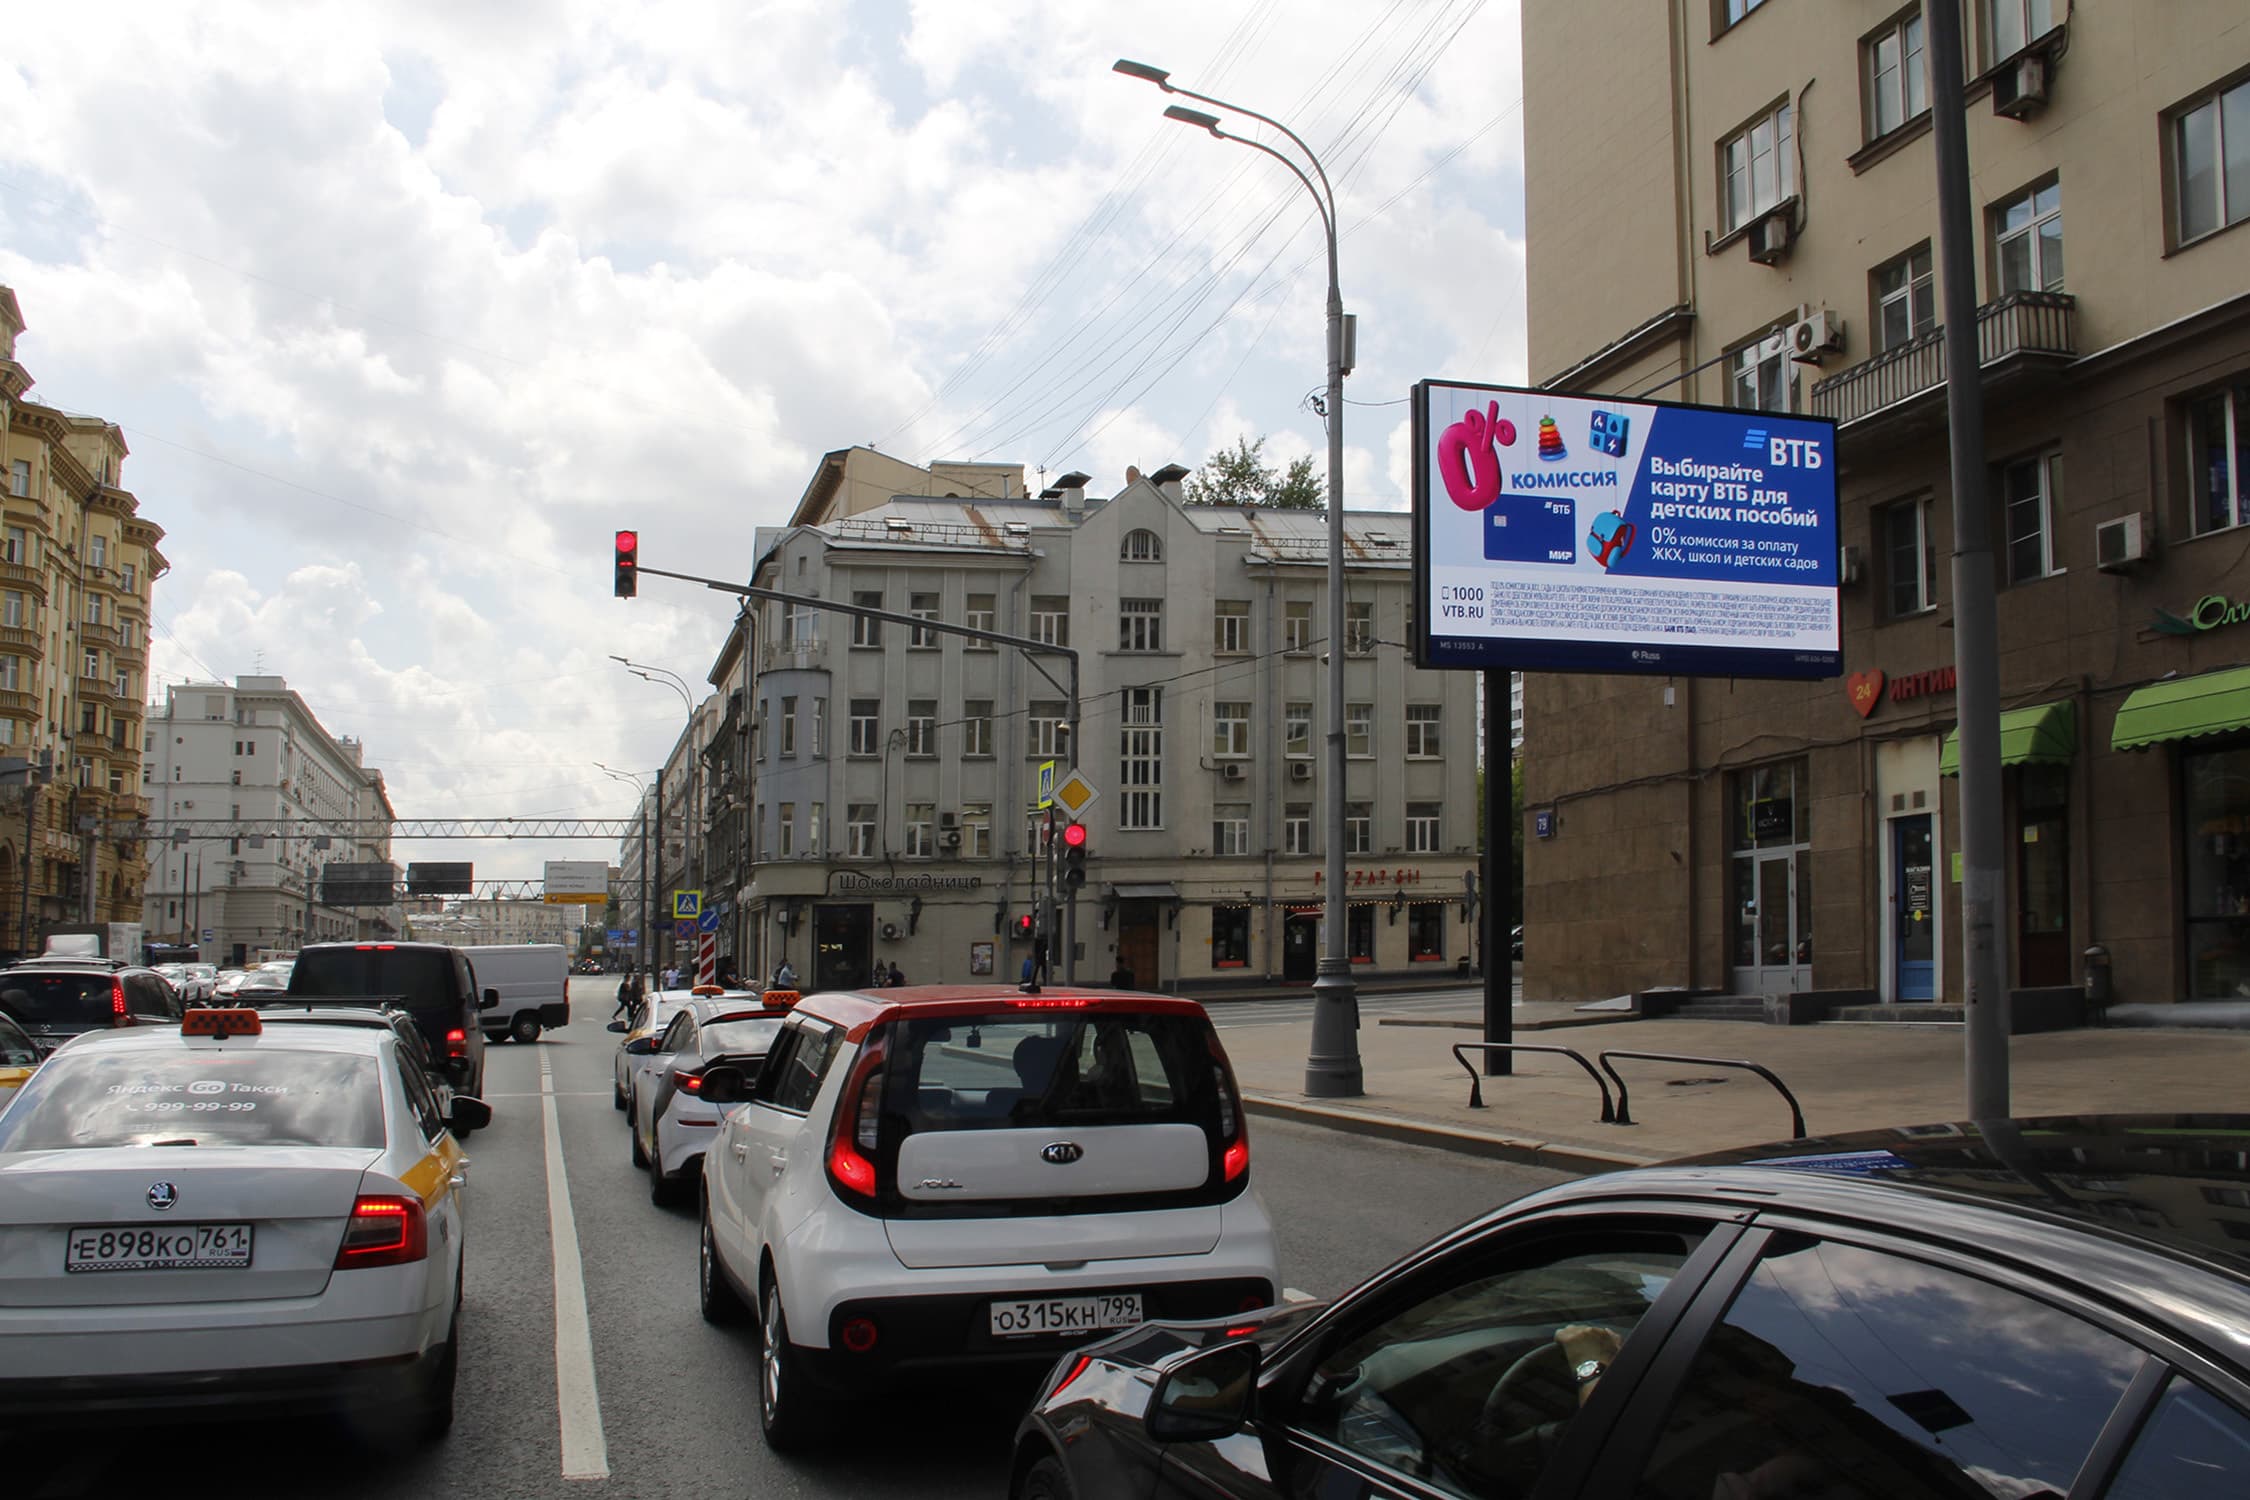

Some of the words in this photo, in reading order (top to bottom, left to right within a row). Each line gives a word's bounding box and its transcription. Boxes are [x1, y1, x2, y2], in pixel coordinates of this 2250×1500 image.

[1438, 400, 1517, 512] 0%
[1770, 437, 1823, 470] ВТБ
[1650, 456, 1764, 483] Выбирайте
[1651, 481, 1709, 503] карту
[1713, 482, 1749, 502] ВТБ
[1751, 489, 1789, 506] для
[1552, 503, 1571, 515] ВТБ
[1650, 502, 1732, 521] детских
[1735, 506, 1819, 527] пособий
[1651, 526, 1678, 545] 0%
[1680, 535, 1739, 550] комиссия
[1741, 539, 1755, 550] за
[1757, 540, 1799, 556] оплату
[1549, 550, 1573, 561] МИР
[1651, 547, 1685, 563] ЖКХ,
[1688, 551, 1721, 564] школ
[1723, 554, 1732, 564] и
[1734, 554, 1783, 568] детских
[1784, 557, 1819, 571] садов
[1452, 586, 1484, 601] 1000
[1442, 604, 1485, 619] VTB.RU
[1856, 683, 1872, 700] 24
[1889, 665, 1957, 702] ИНТИМ
[839, 873, 982, 890] Шоколадница
[106, 1083, 185, 1095] Яндекс
[230, 1083, 288, 1095] Такси
[143, 1102, 257, 1112] 999-99-99
[1048, 1146, 1077, 1160] KIA
[200, 1227, 243, 1249] 761
[209, 1248, 231, 1257] RUS
[143, 1259, 177, 1268] TAXI
[1100, 1296, 1136, 1317] 799
